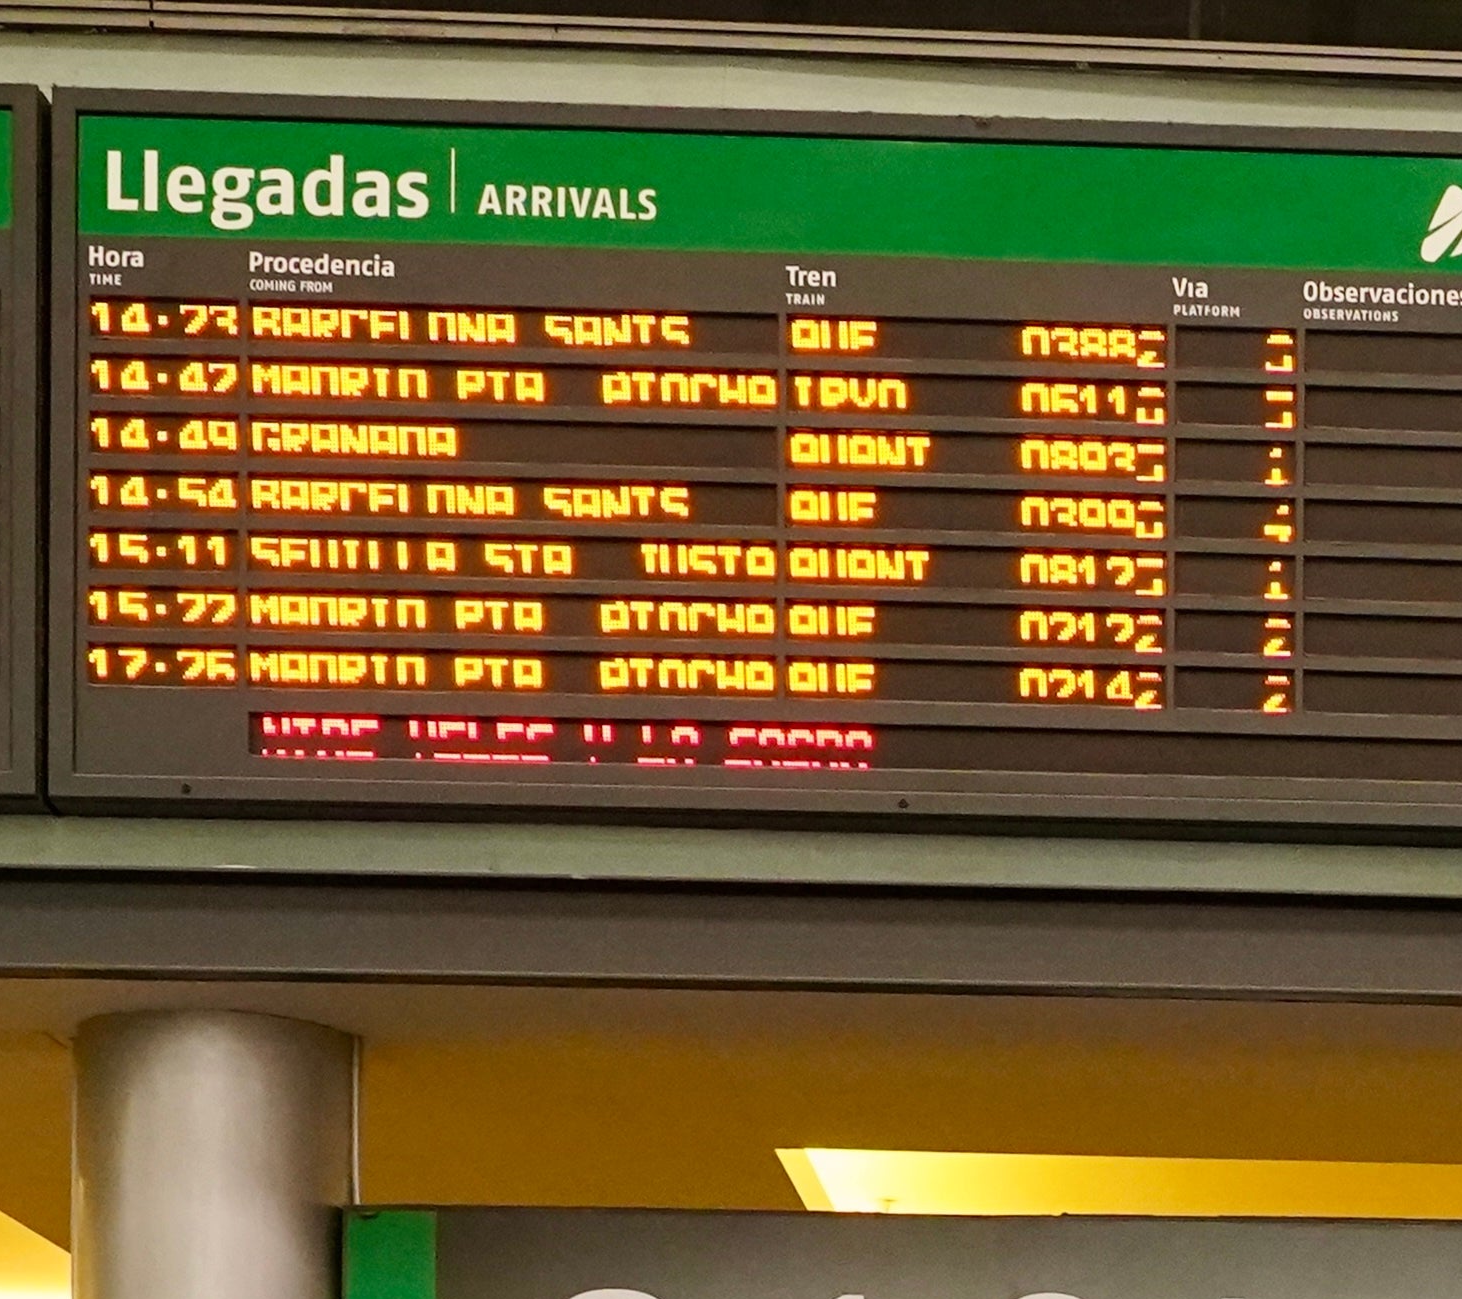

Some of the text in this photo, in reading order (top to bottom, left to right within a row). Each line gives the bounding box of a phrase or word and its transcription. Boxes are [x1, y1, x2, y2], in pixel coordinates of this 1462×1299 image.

[106, 149, 429, 230] Llegadas
[478, 185, 657, 221] ARRIVALS
[88, 246, 143, 268] Hora
[249, 251, 394, 278] Procedencia
[89, 274, 121, 286] TIME
[786, 266, 836, 287] Tren
[249, 279, 332, 293] COMING FROM
[786, 293, 825, 306] TRAIN
[1173, 305, 1240, 317] PLATFORM
[1303, 309, 1399, 322] OBSERVATIONS
